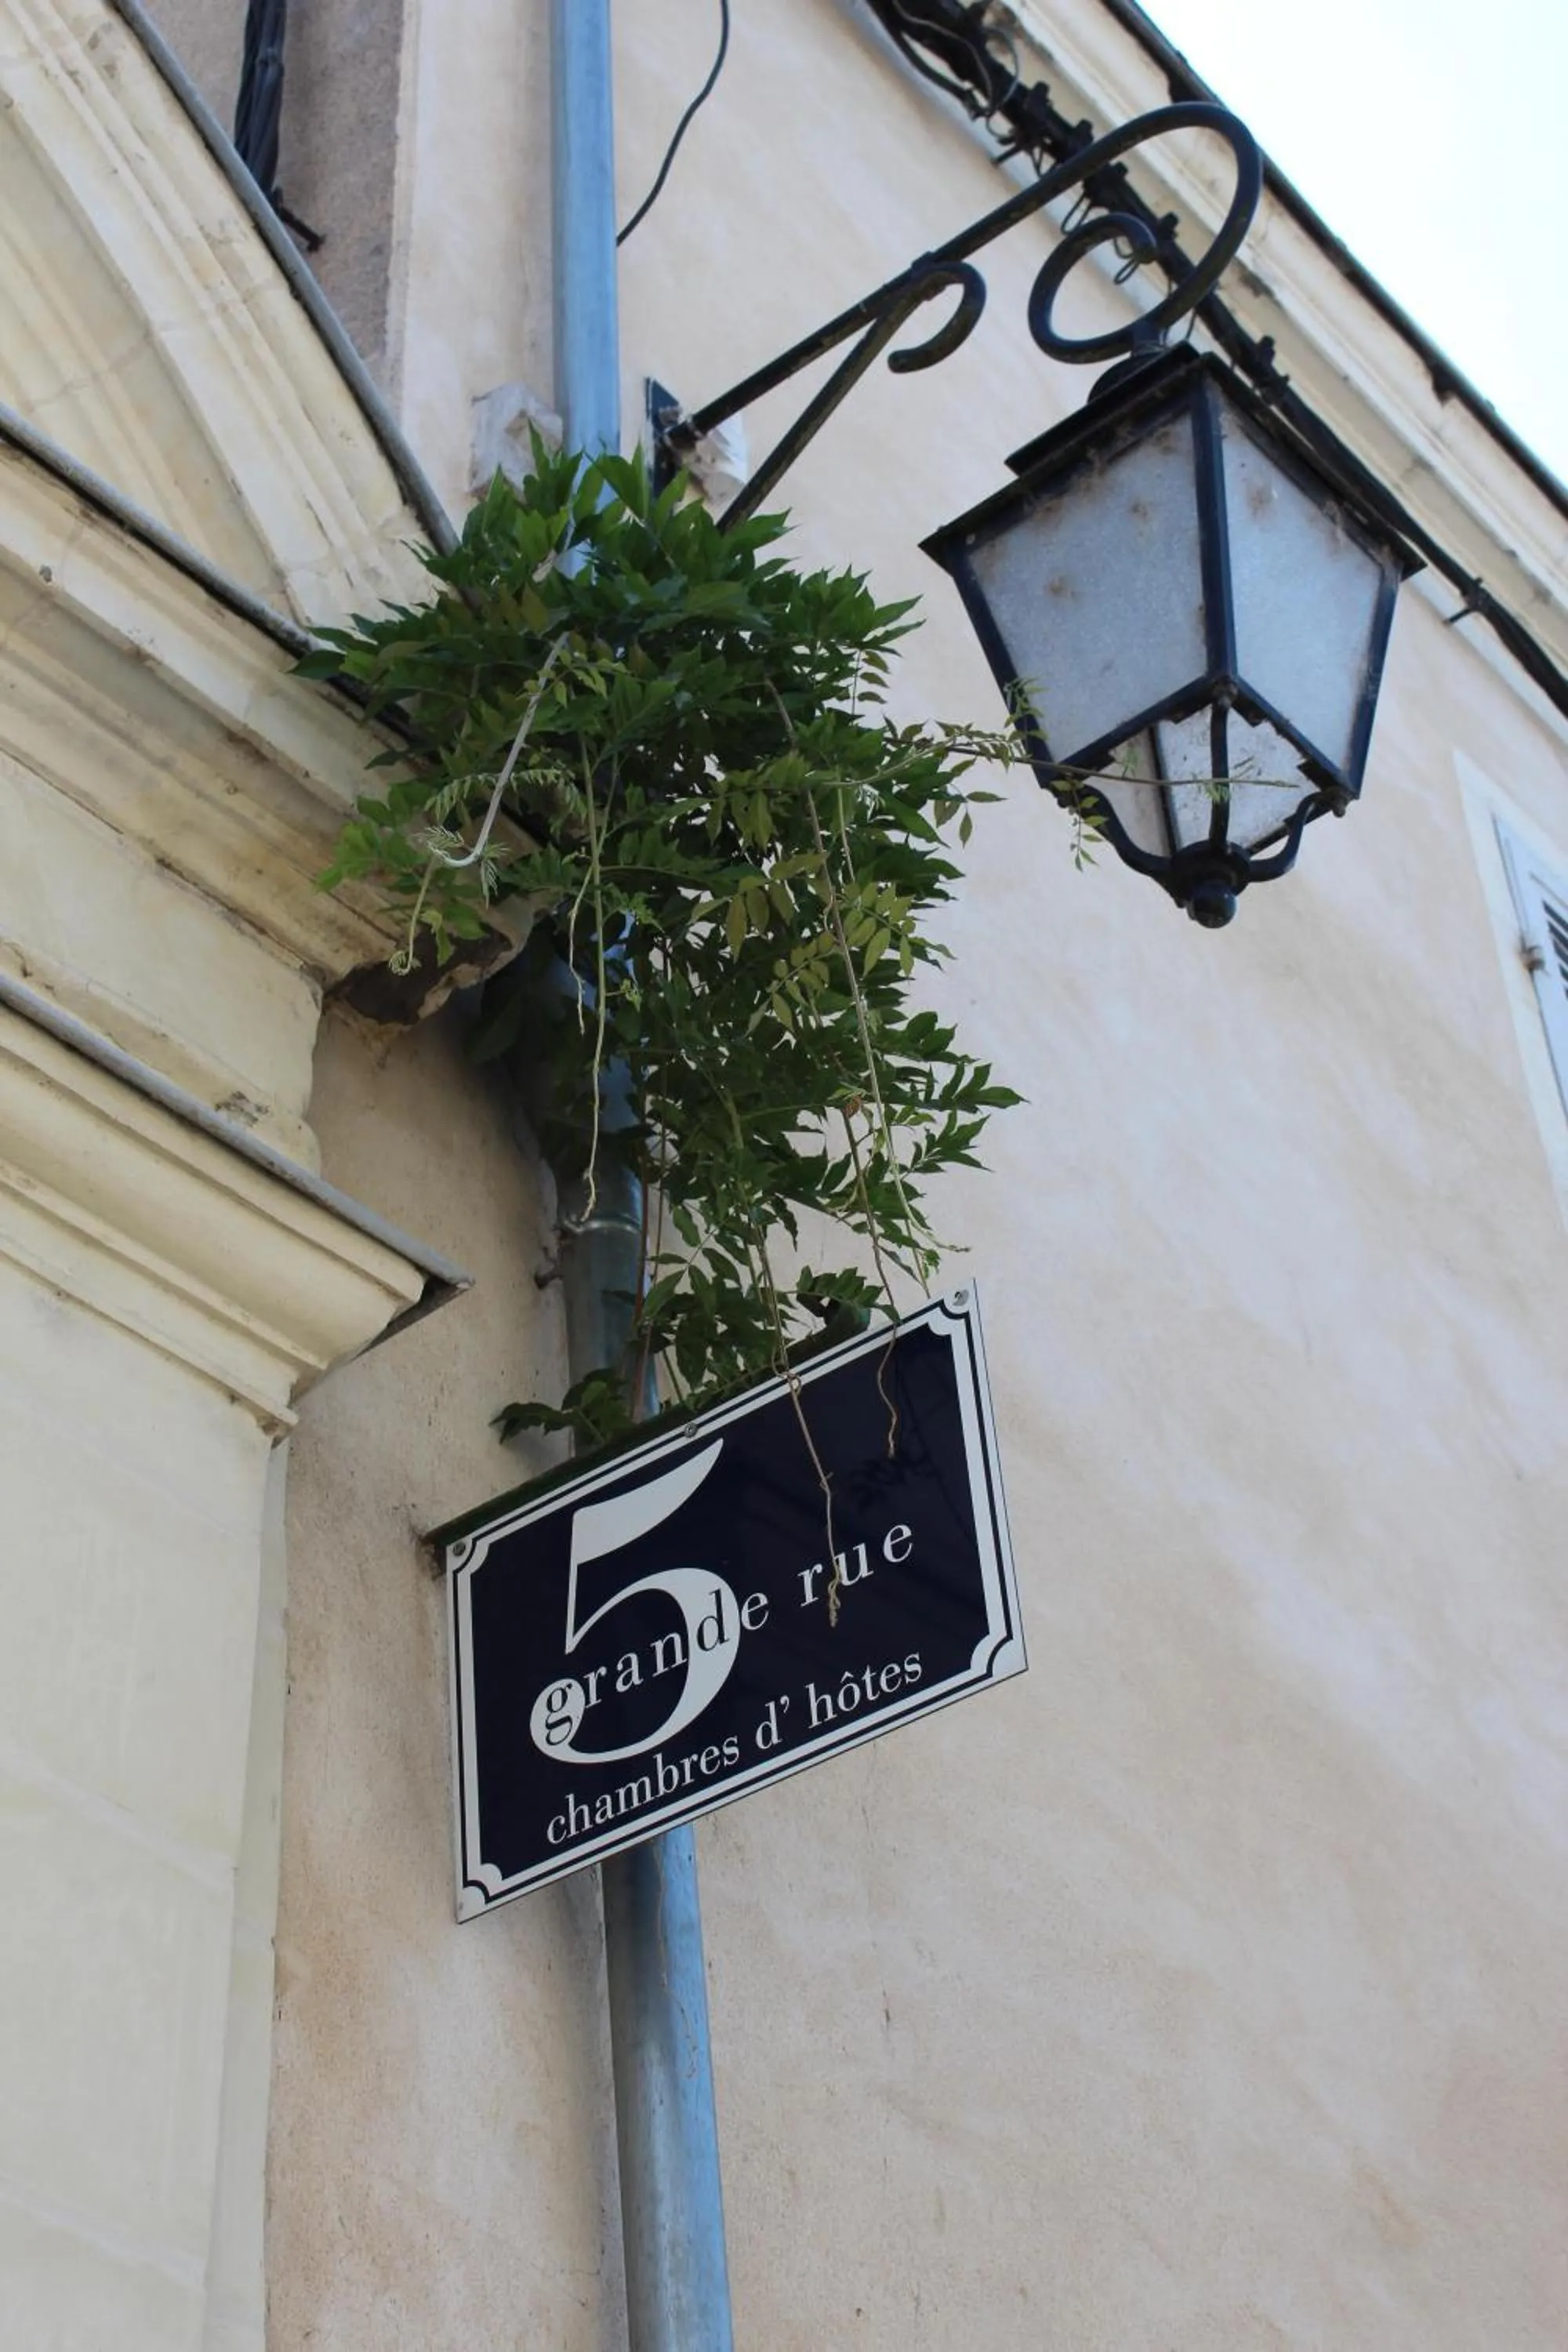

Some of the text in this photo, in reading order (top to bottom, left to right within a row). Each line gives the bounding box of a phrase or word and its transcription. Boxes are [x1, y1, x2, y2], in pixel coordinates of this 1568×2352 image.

[530, 1438, 741, 1764] 5
[543, 1523, 913, 1746] grande rue
[546, 1735, 741, 1845] chambres
[805, 1652, 923, 1729] hôtes
